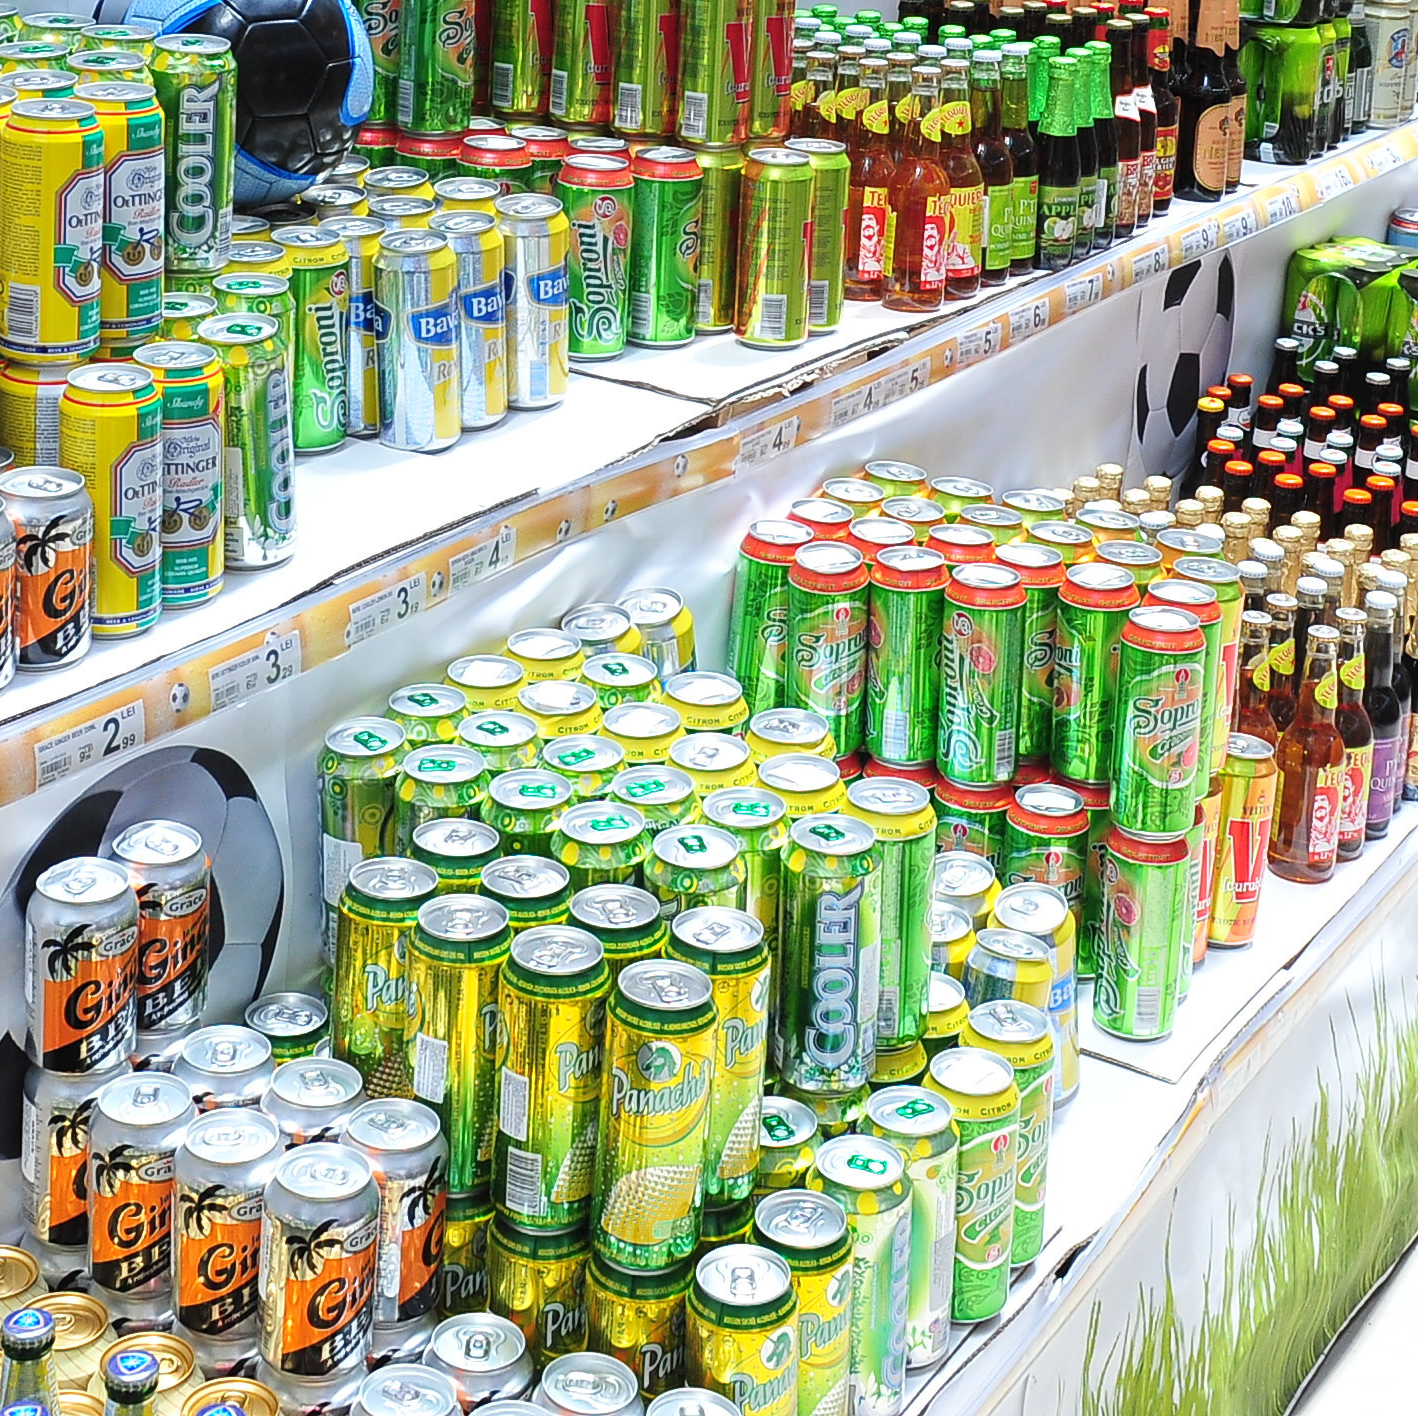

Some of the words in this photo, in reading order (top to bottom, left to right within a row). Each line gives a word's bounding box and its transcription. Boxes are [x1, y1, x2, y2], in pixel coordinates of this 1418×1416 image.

[169, 79, 219, 248] COOLER
[396, 584, 409, 620] 3
[410, 601, 421, 614] 19
[265, 649, 281, 685] 3
[280, 665, 294, 681] 29
[102, 716, 122, 755] 2
[121, 733, 136, 750] 99
